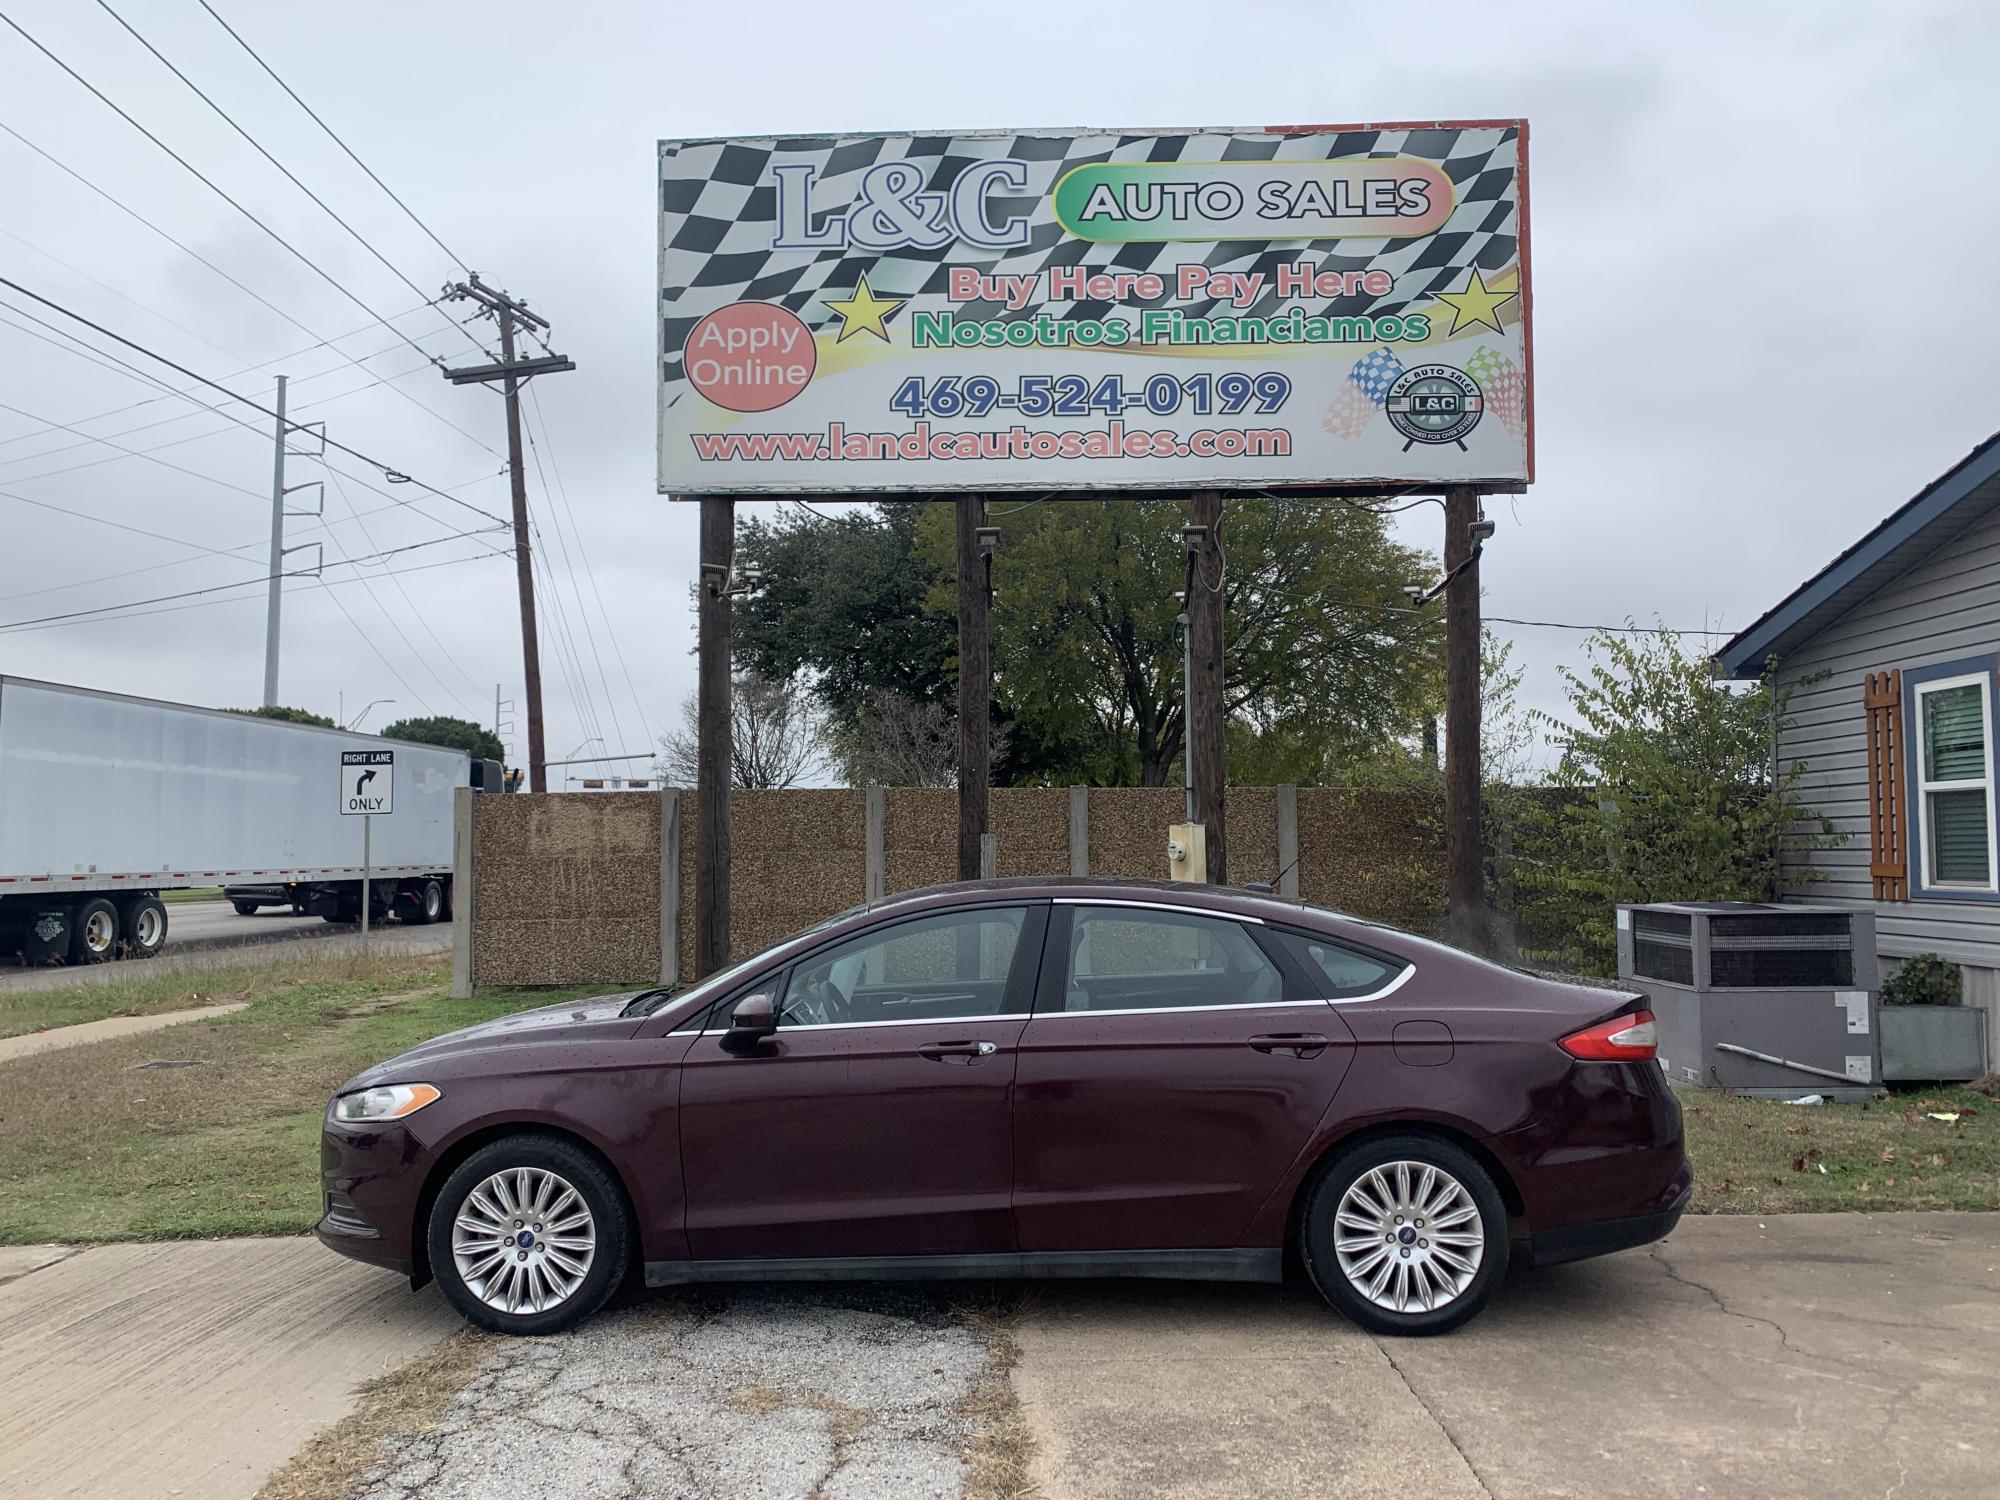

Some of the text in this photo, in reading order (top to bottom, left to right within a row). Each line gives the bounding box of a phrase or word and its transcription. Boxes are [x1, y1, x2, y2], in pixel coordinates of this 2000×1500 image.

[772, 161, 1431, 248] L&C AUTO SALES
[946, 262, 1394, 310] Buy Here Pay Here
[699, 320, 800, 353] Apply
[913, 308, 1431, 347] Nosotros Financiamos
[691, 359, 808, 386] Online
[1393, 368, 1475, 394] L&C AUTO SALES
[890, 374, 1293, 418] 469-524-0199
[1415, 397, 1455, 412] L&C
[690, 420, 1293, 461] www.landcautosales.com
[1441, 429, 1457, 439] OVER
[344, 753, 391, 763] RIGHT LANE
[349, 798, 384, 811] ONLY
